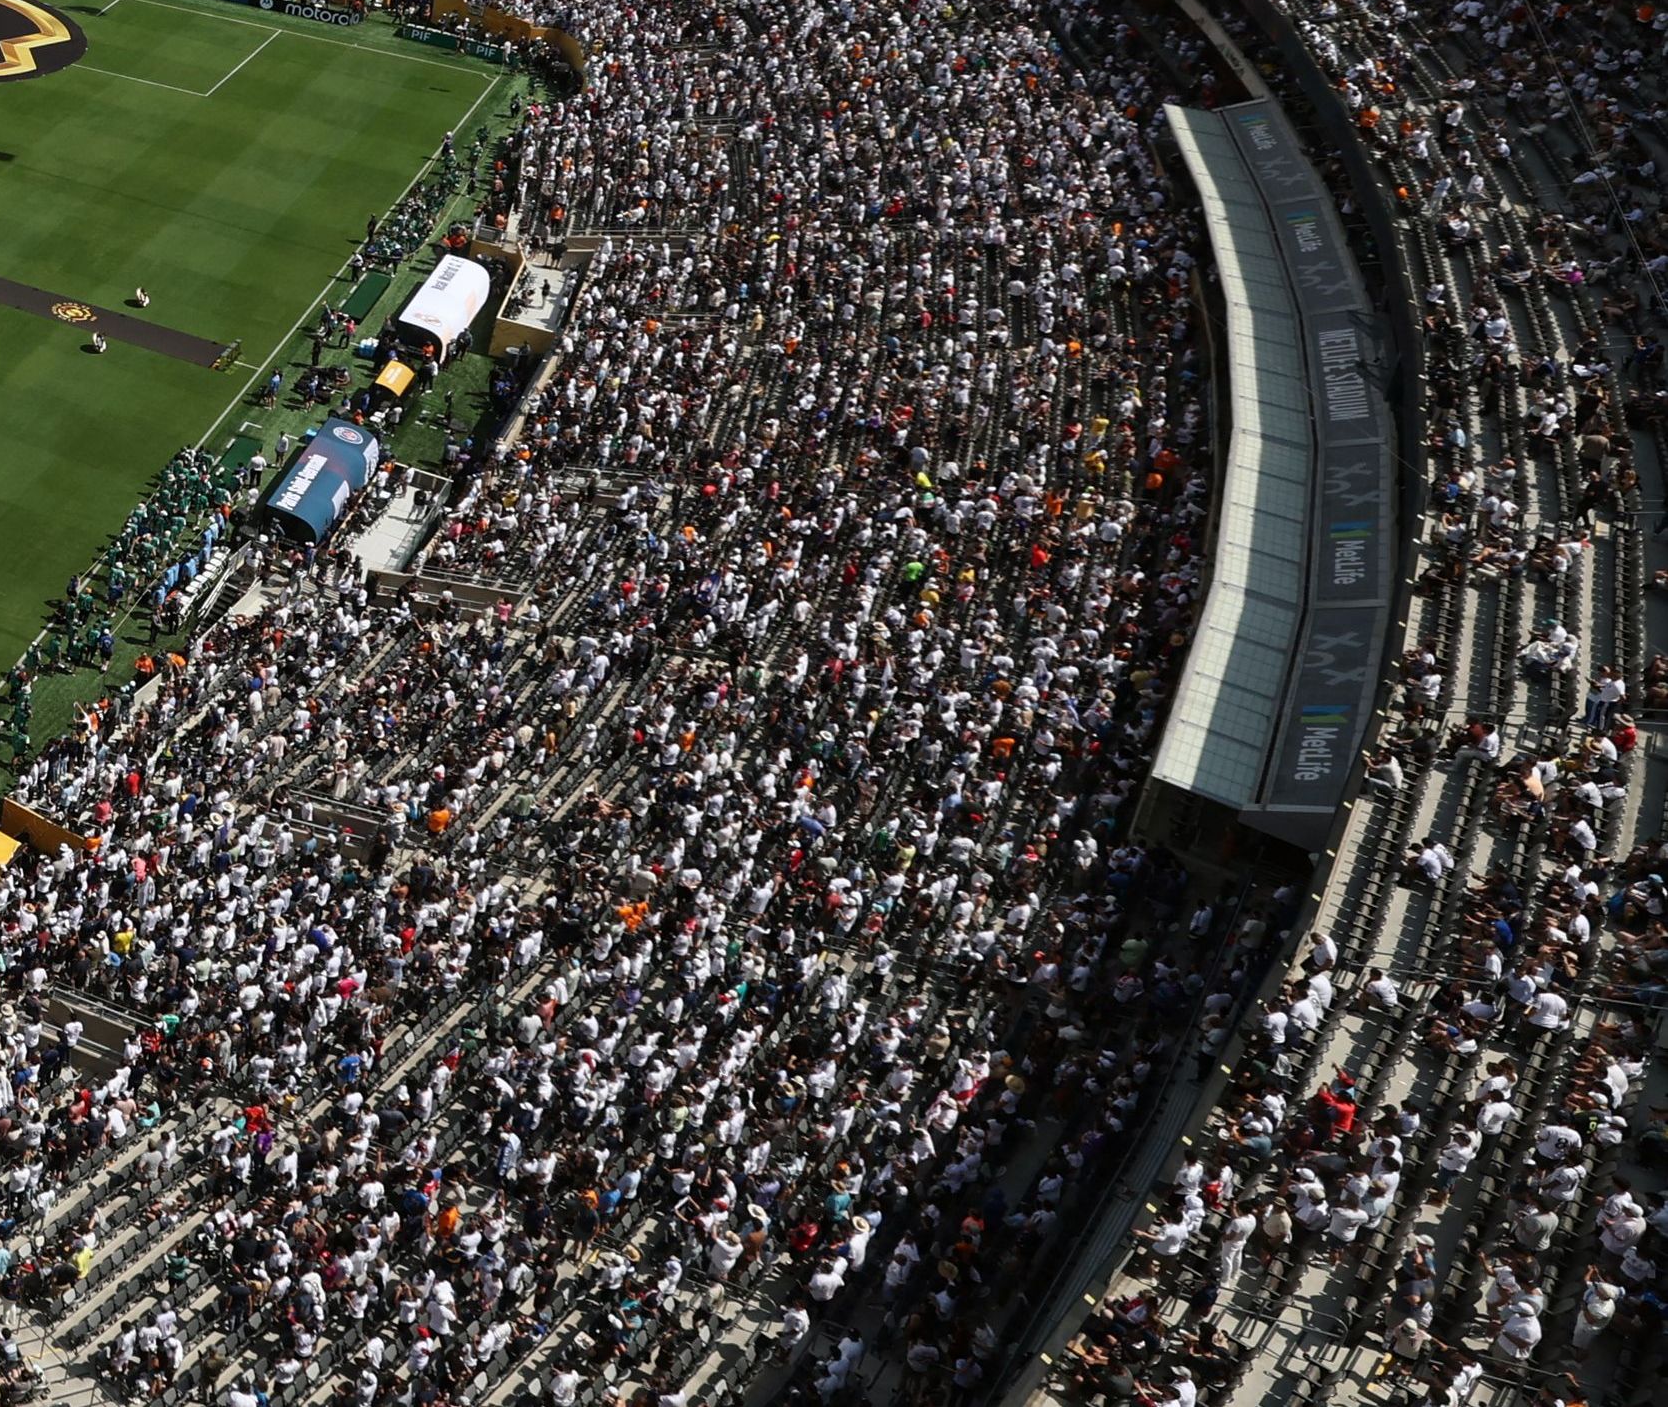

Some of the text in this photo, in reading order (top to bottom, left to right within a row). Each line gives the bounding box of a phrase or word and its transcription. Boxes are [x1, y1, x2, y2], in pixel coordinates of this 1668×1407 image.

[411, 30, 432, 42] PIF
[475, 43, 497, 58] PIF
[1294, 221, 1323, 253] MetLife
[1319, 327, 1370, 422] METLIFE STADIUM
[1332, 539, 1365, 586] MetLife
[1294, 726, 1340, 781] MetLife
